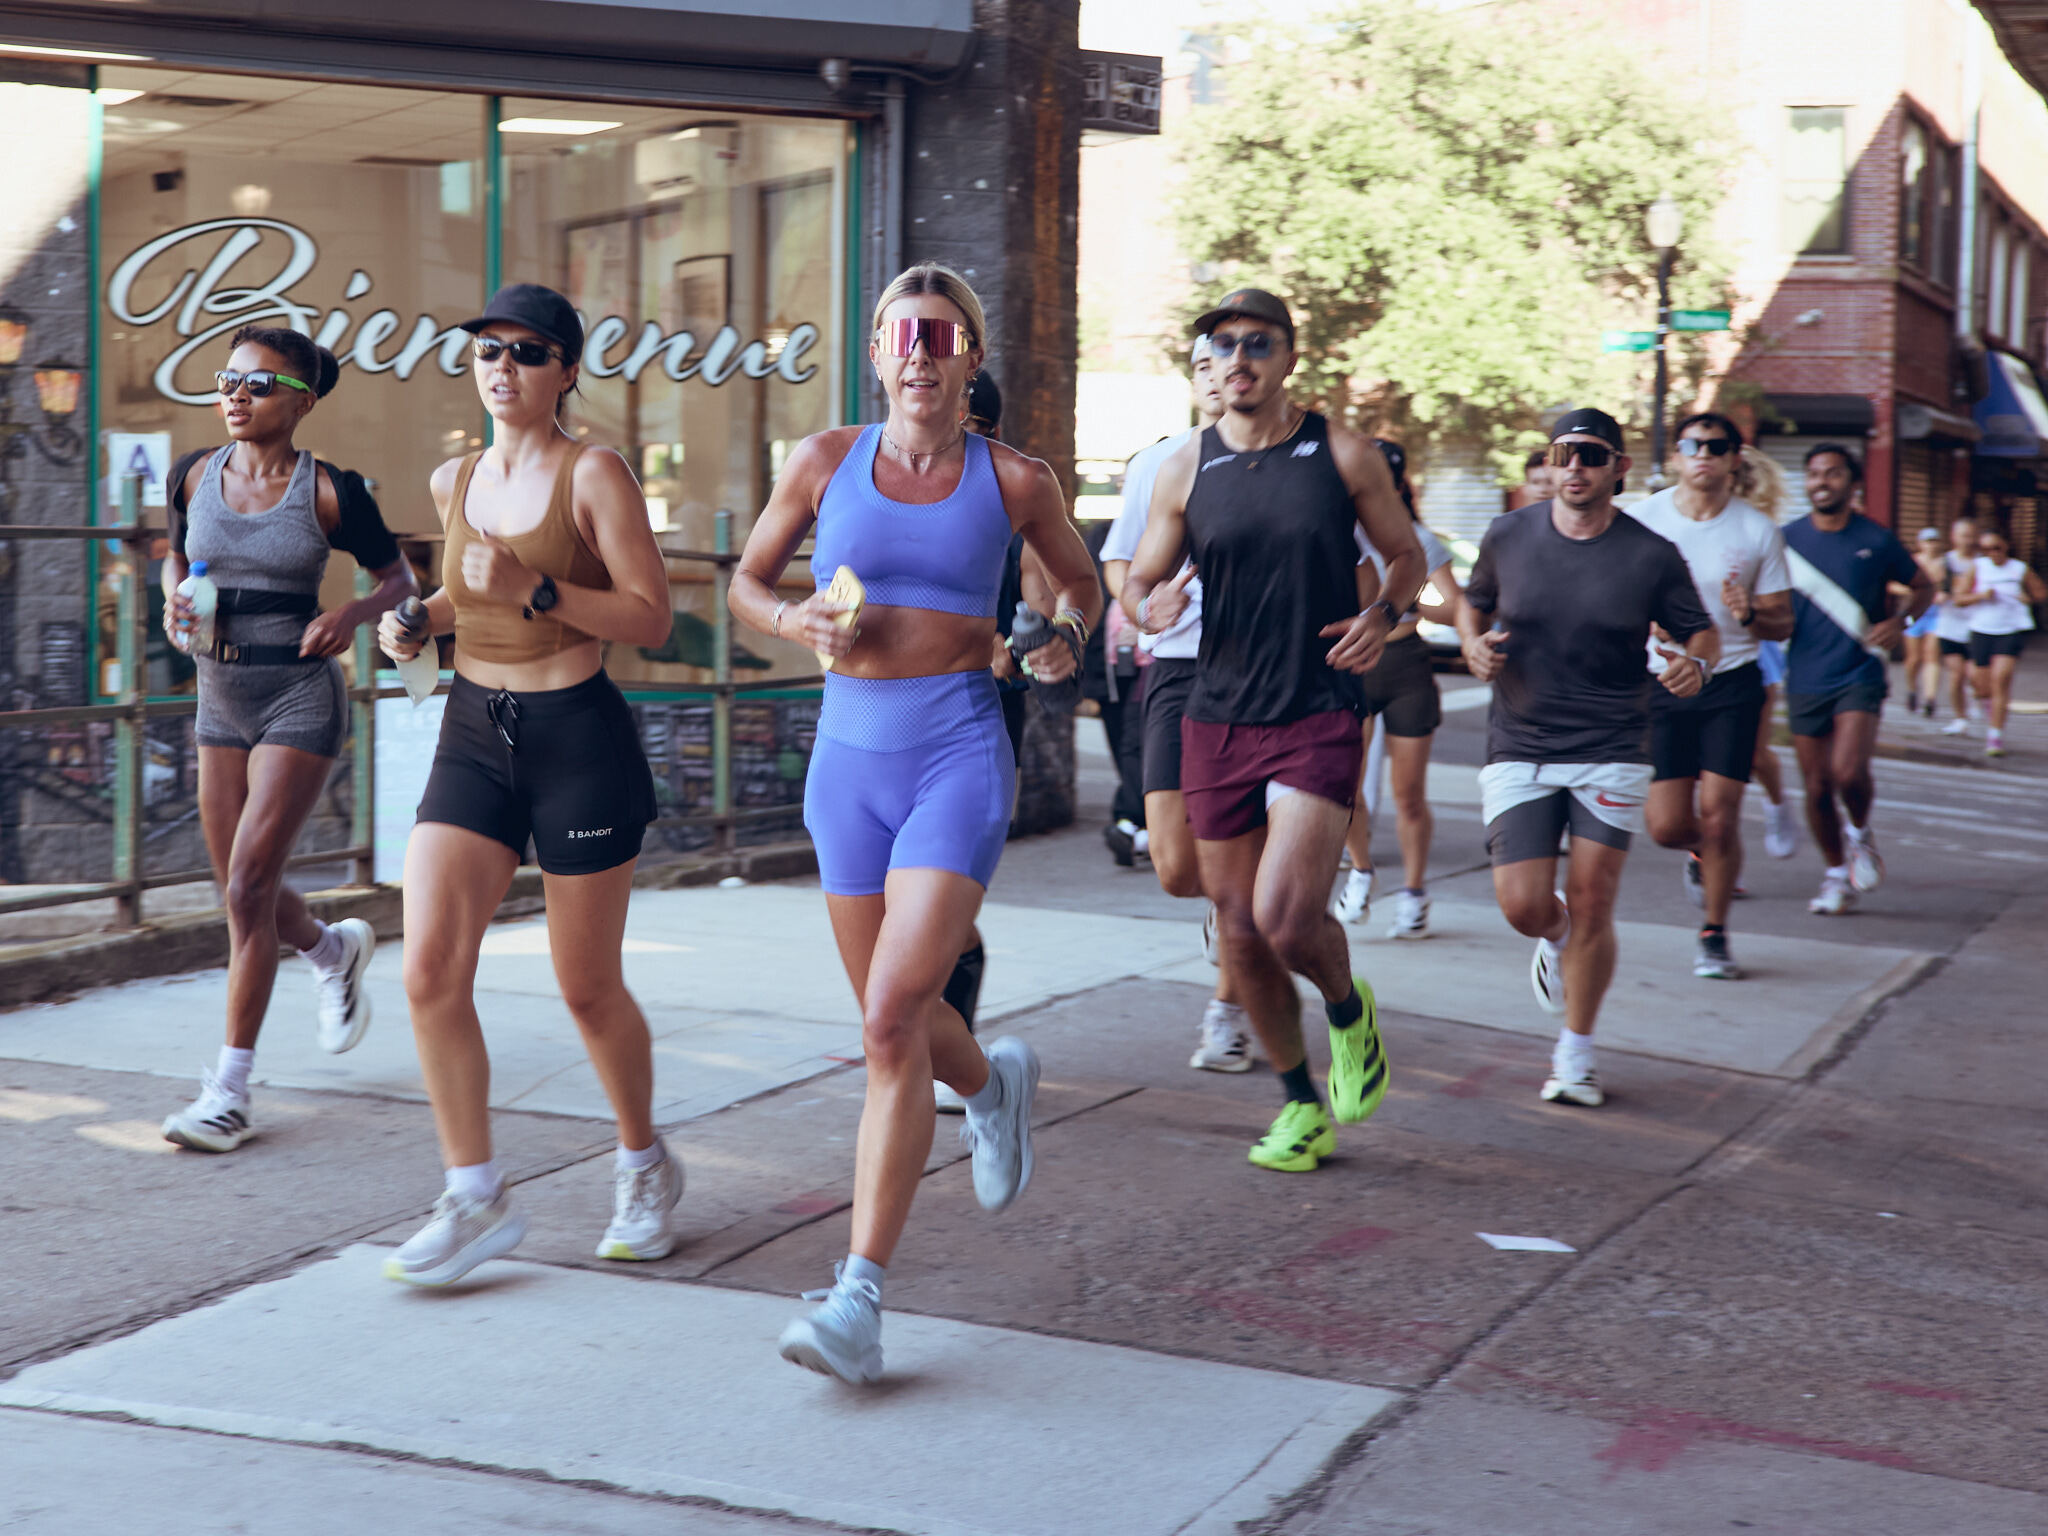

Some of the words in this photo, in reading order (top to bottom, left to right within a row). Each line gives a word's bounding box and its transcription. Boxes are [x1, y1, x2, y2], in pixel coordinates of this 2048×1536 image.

[107, 216, 820, 406] Bienenue
[124, 444, 157, 484] A
[577, 828, 612, 838] BANDIT
